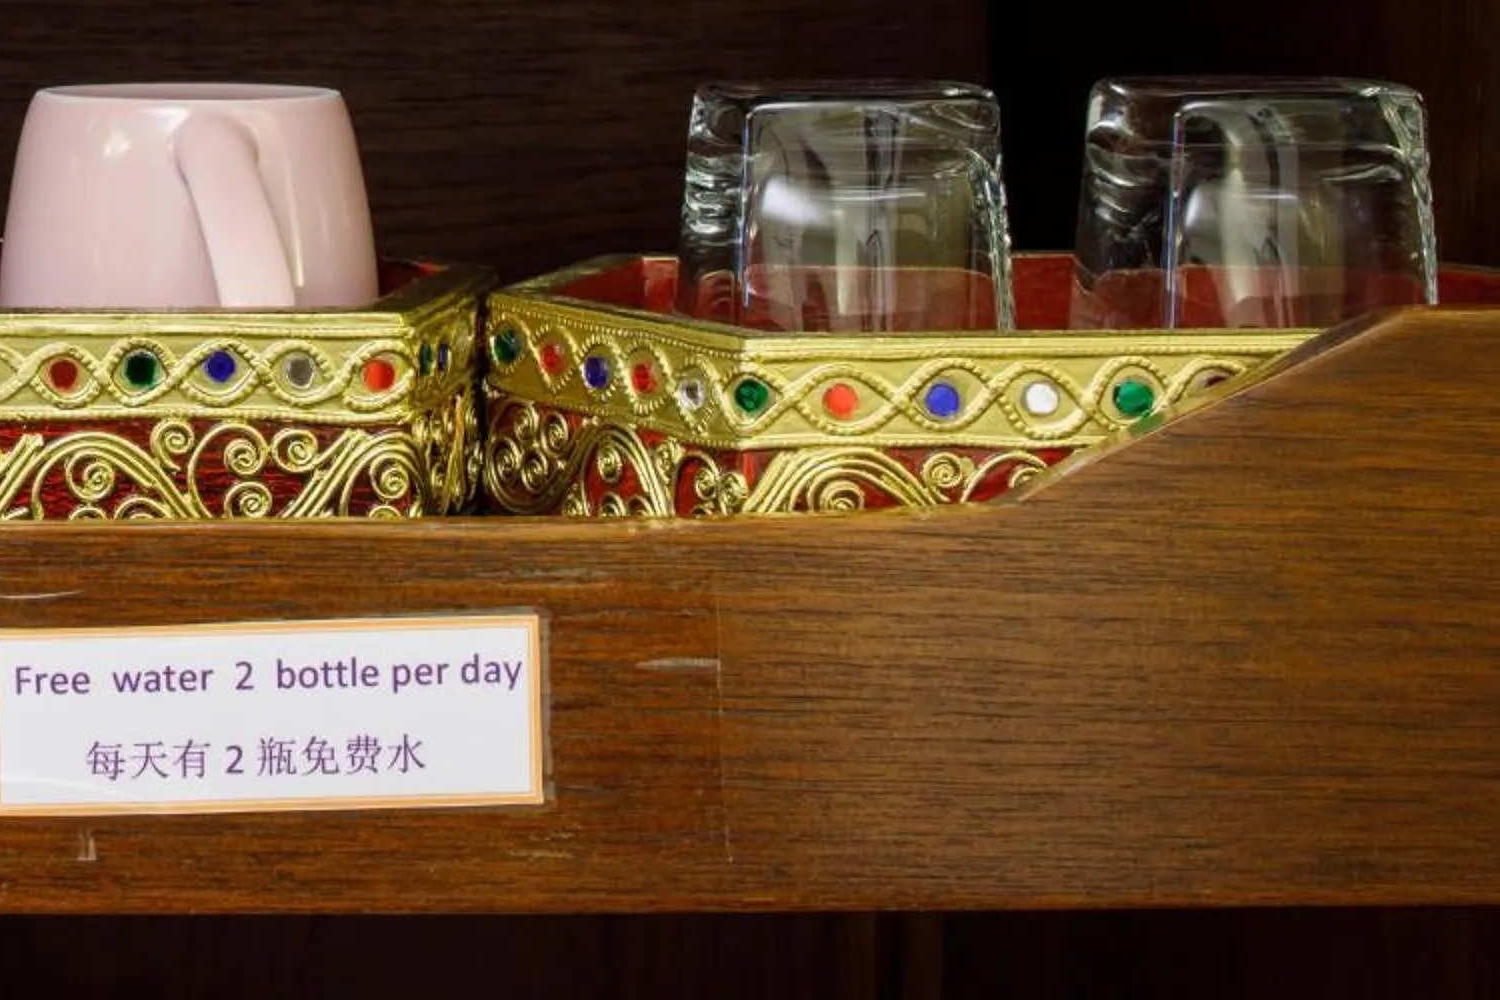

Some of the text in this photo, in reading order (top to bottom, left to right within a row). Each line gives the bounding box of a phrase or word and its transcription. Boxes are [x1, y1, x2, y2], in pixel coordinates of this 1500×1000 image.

[15, 652, 523, 696] Free water 2 bottle per day
